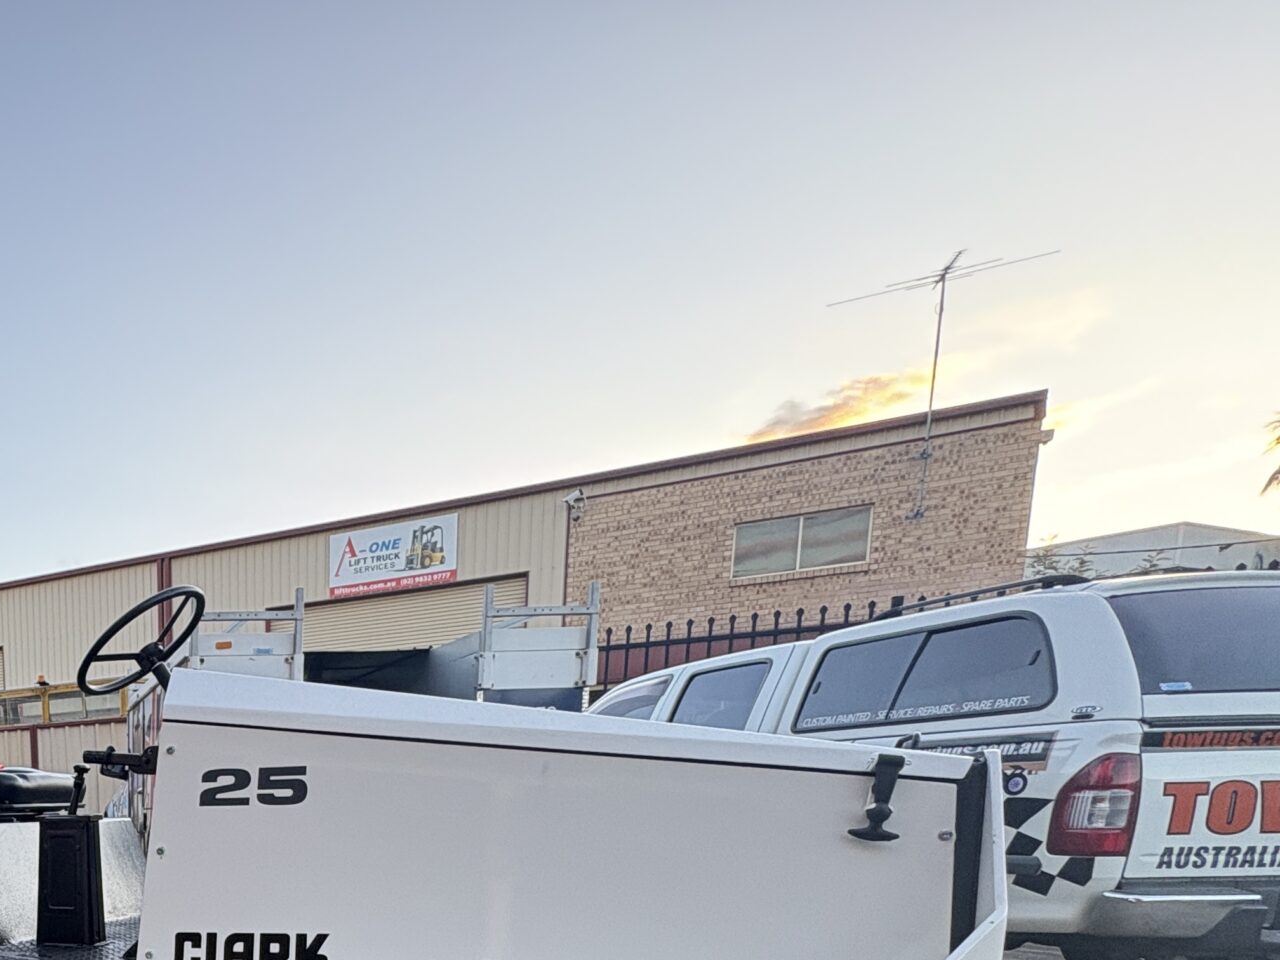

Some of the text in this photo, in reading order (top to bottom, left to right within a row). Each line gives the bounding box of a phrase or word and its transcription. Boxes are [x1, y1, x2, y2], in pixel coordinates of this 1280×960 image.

[335, 536, 401, 577] A-ONE
[348, 552, 400, 567] LIFT TRUCK
[353, 562, 396, 574] SERVICES
[803, 716, 837, 727] CUSTOM
[836, 711, 871, 724] PAINTED
[960, 699, 995, 713] SPARE
[994, 695, 1031, 709] PARTS
[199, 766, 308, 807] 25
[1155, 844, 1280, 870] AUSTRALI
